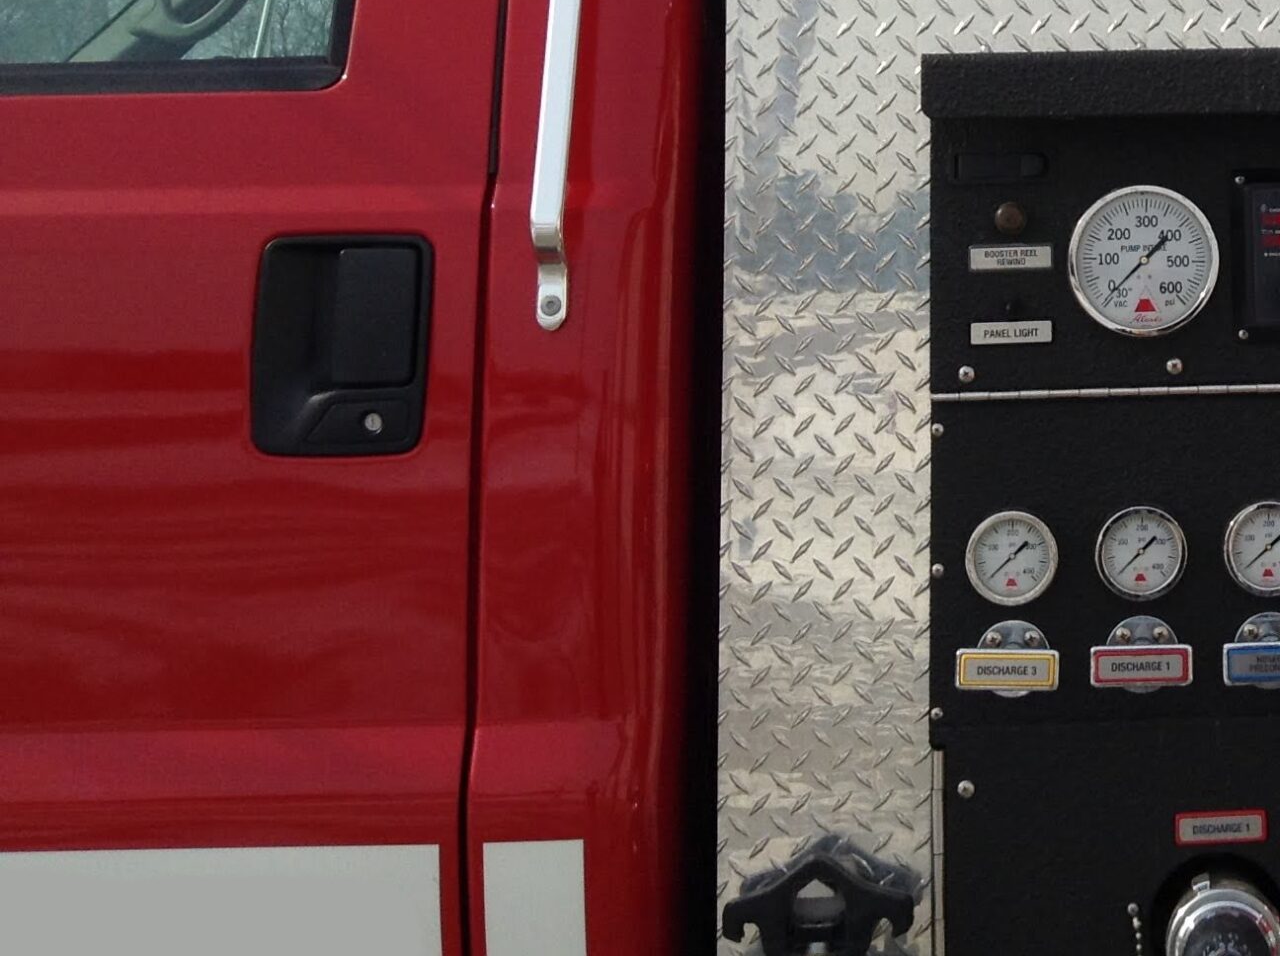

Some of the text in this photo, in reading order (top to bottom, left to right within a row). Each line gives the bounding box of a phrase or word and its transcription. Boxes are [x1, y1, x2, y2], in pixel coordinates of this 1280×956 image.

[1135, 215, 1158, 228] 300
[1107, 228, 1130, 241] 200
[1158, 229, 1181, 241] 400
[984, 250, 1018, 258] BOOSTER
[1098, 253, 1119, 265] 100
[1167, 256, 1189, 267] 500
[1108, 280, 1116, 291] 0
[1159, 281, 1182, 294] 600
[984, 328, 1038, 338] PANEL LIGHT
[977, 666, 1037, 676] DISCHARGE 3
[1111, 661, 1170, 672] DISCHARGE 1
[1193, 823, 1250, 835] DISCHARGE 1
